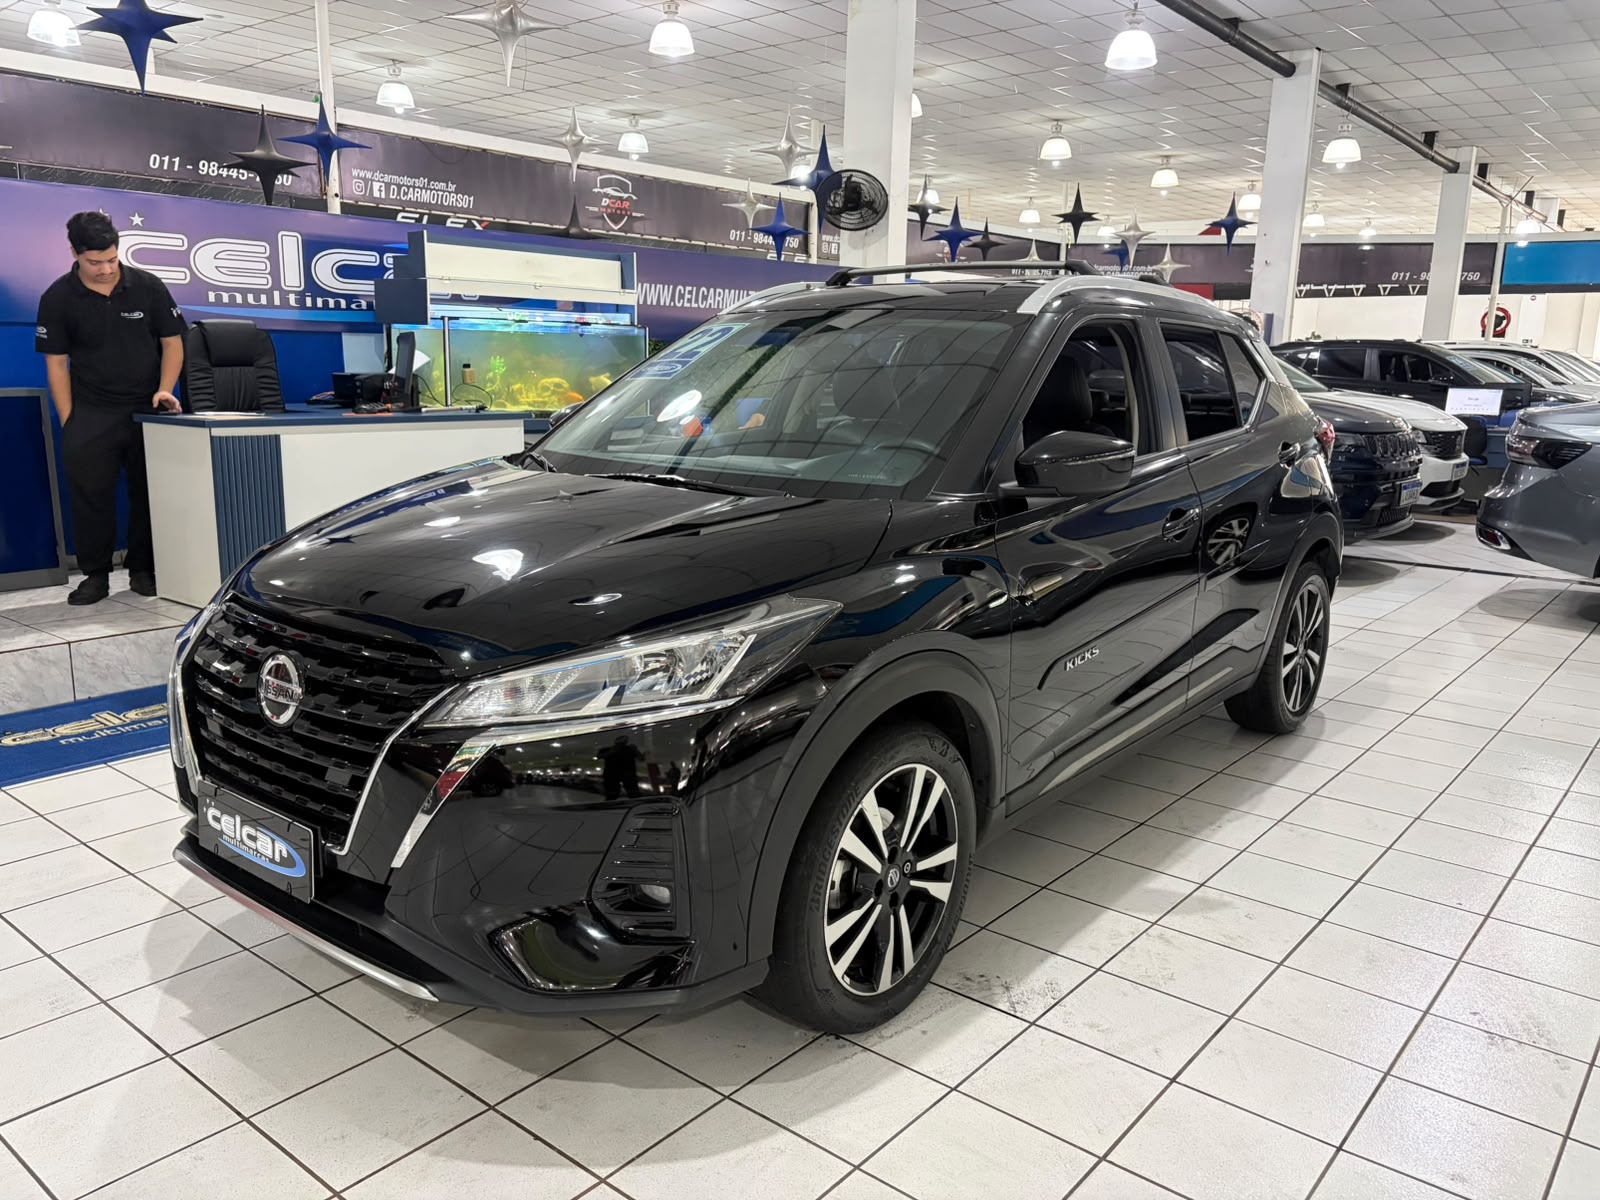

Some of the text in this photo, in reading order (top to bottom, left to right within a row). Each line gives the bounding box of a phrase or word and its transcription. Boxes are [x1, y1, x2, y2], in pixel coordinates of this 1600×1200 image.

[149, 153, 181, 171] 011
[198, 160, 293, 186] 98445-50
[351, 167, 457, 192] www.dcarmotors01.com.br
[389, 184, 474, 209] D.CARMOTORS01
[729, 229, 746, 241] 011
[117, 229, 396, 296] celc
[1391, 271, 1410, 281] 011
[208, 288, 376, 311] multima
[1066, 647, 1100, 671] KICKS
[207, 806, 288, 863] celcar
[222, 834, 270, 863] multimarcas
